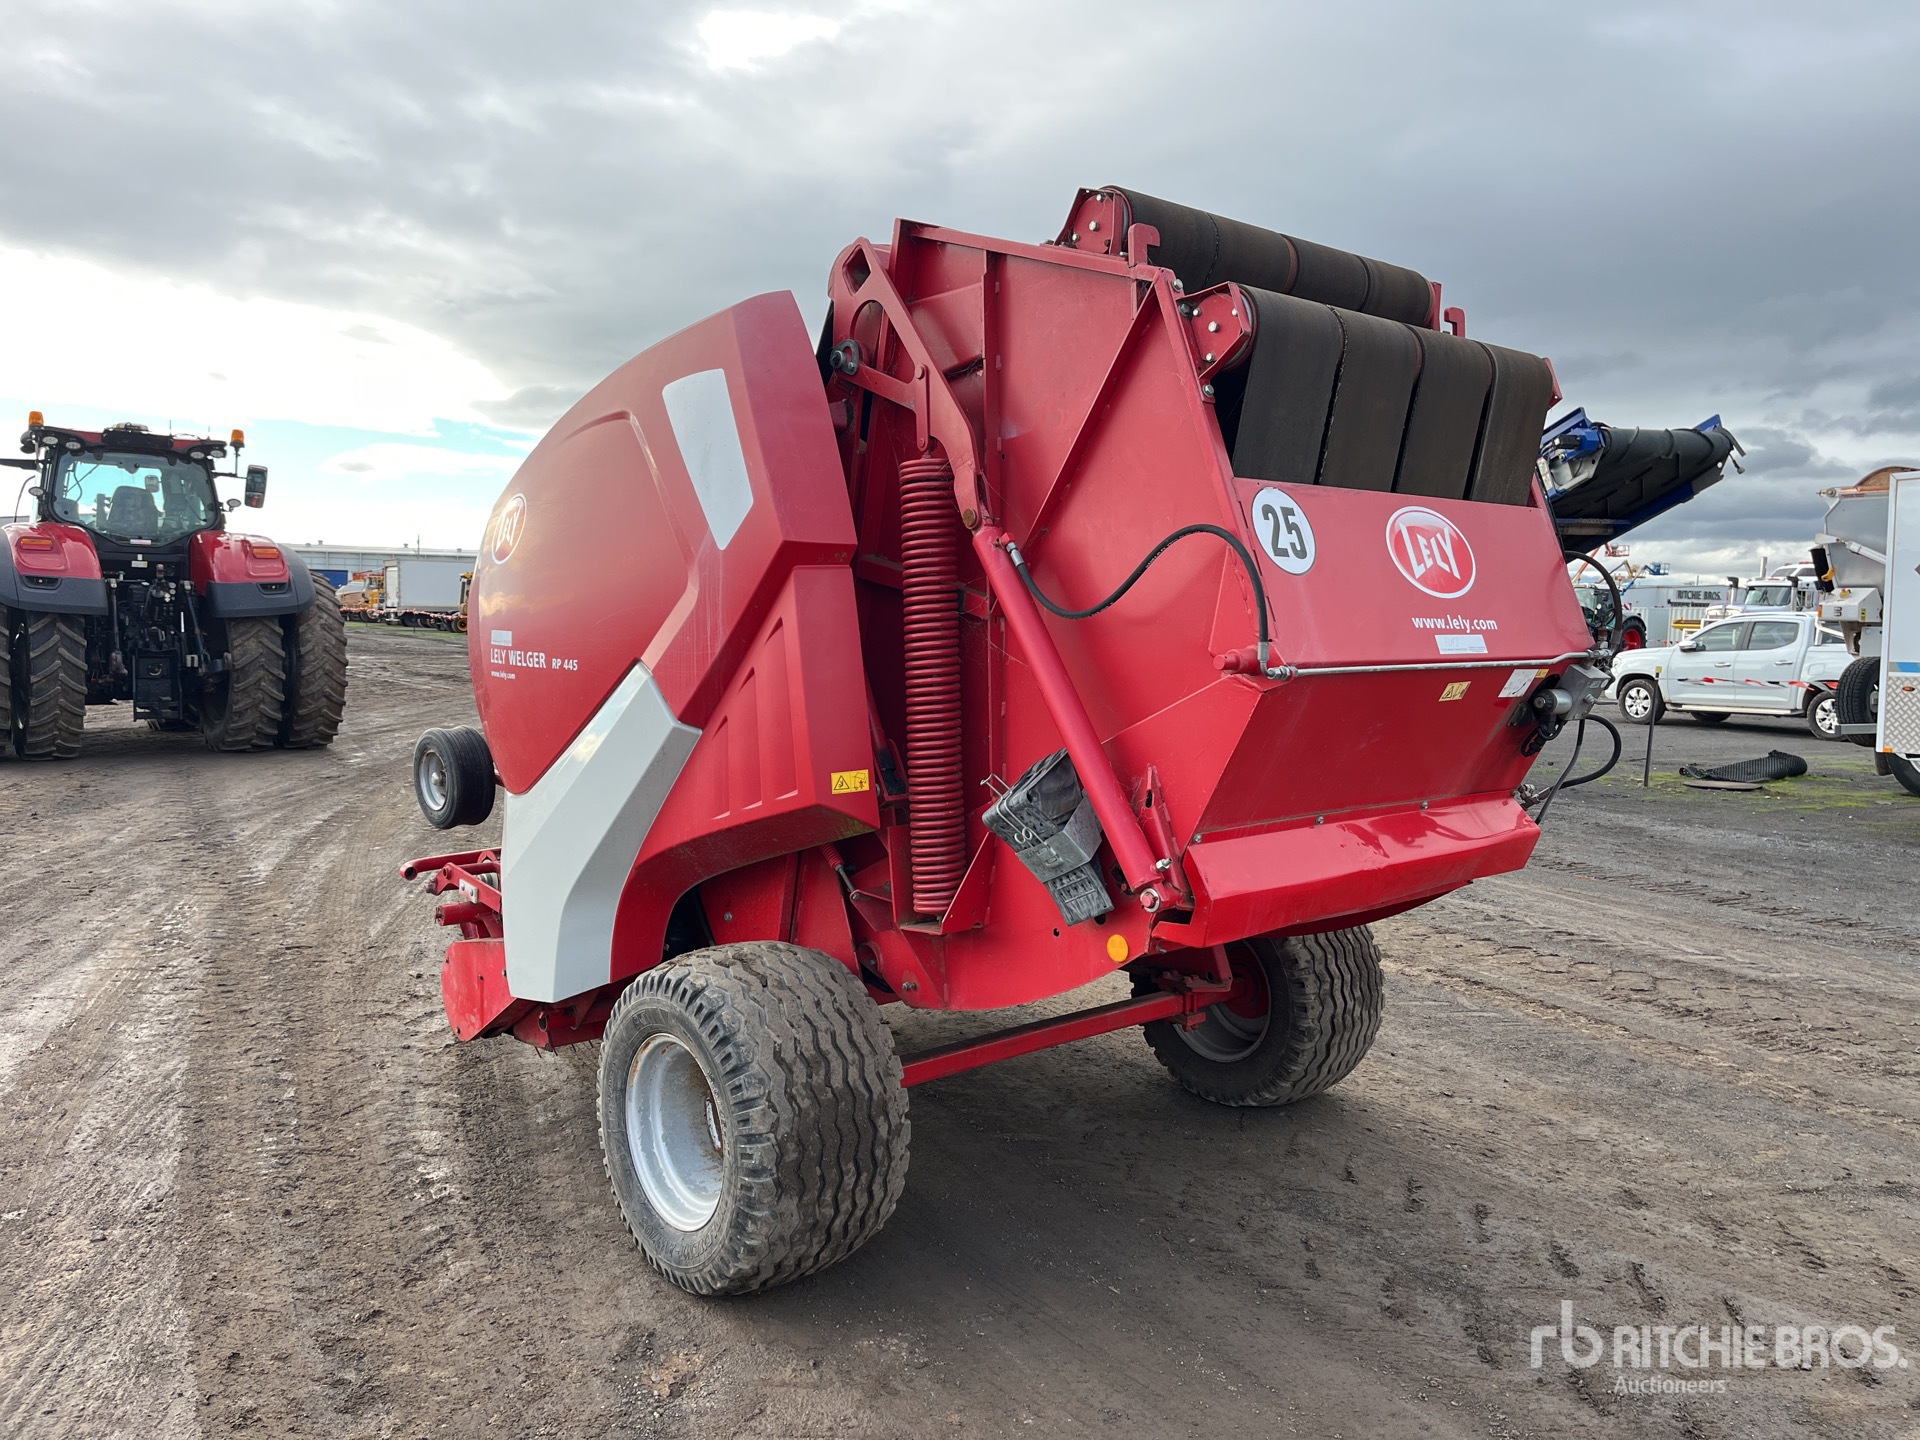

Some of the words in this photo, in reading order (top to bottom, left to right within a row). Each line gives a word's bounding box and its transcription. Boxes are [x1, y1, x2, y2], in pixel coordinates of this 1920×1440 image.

[496, 504, 521, 553] LELY
[1261, 503, 1308, 560] 25
[1399, 521, 1461, 580] LELY
[1677, 590, 1702, 600] RITCHIE
[1411, 614, 1498, 634] www.lely.com
[490, 648, 507, 665] LELY
[508, 649, 547, 669] WELGER
[551, 657, 562, 670] RP
[563, 658, 578, 671] 445
